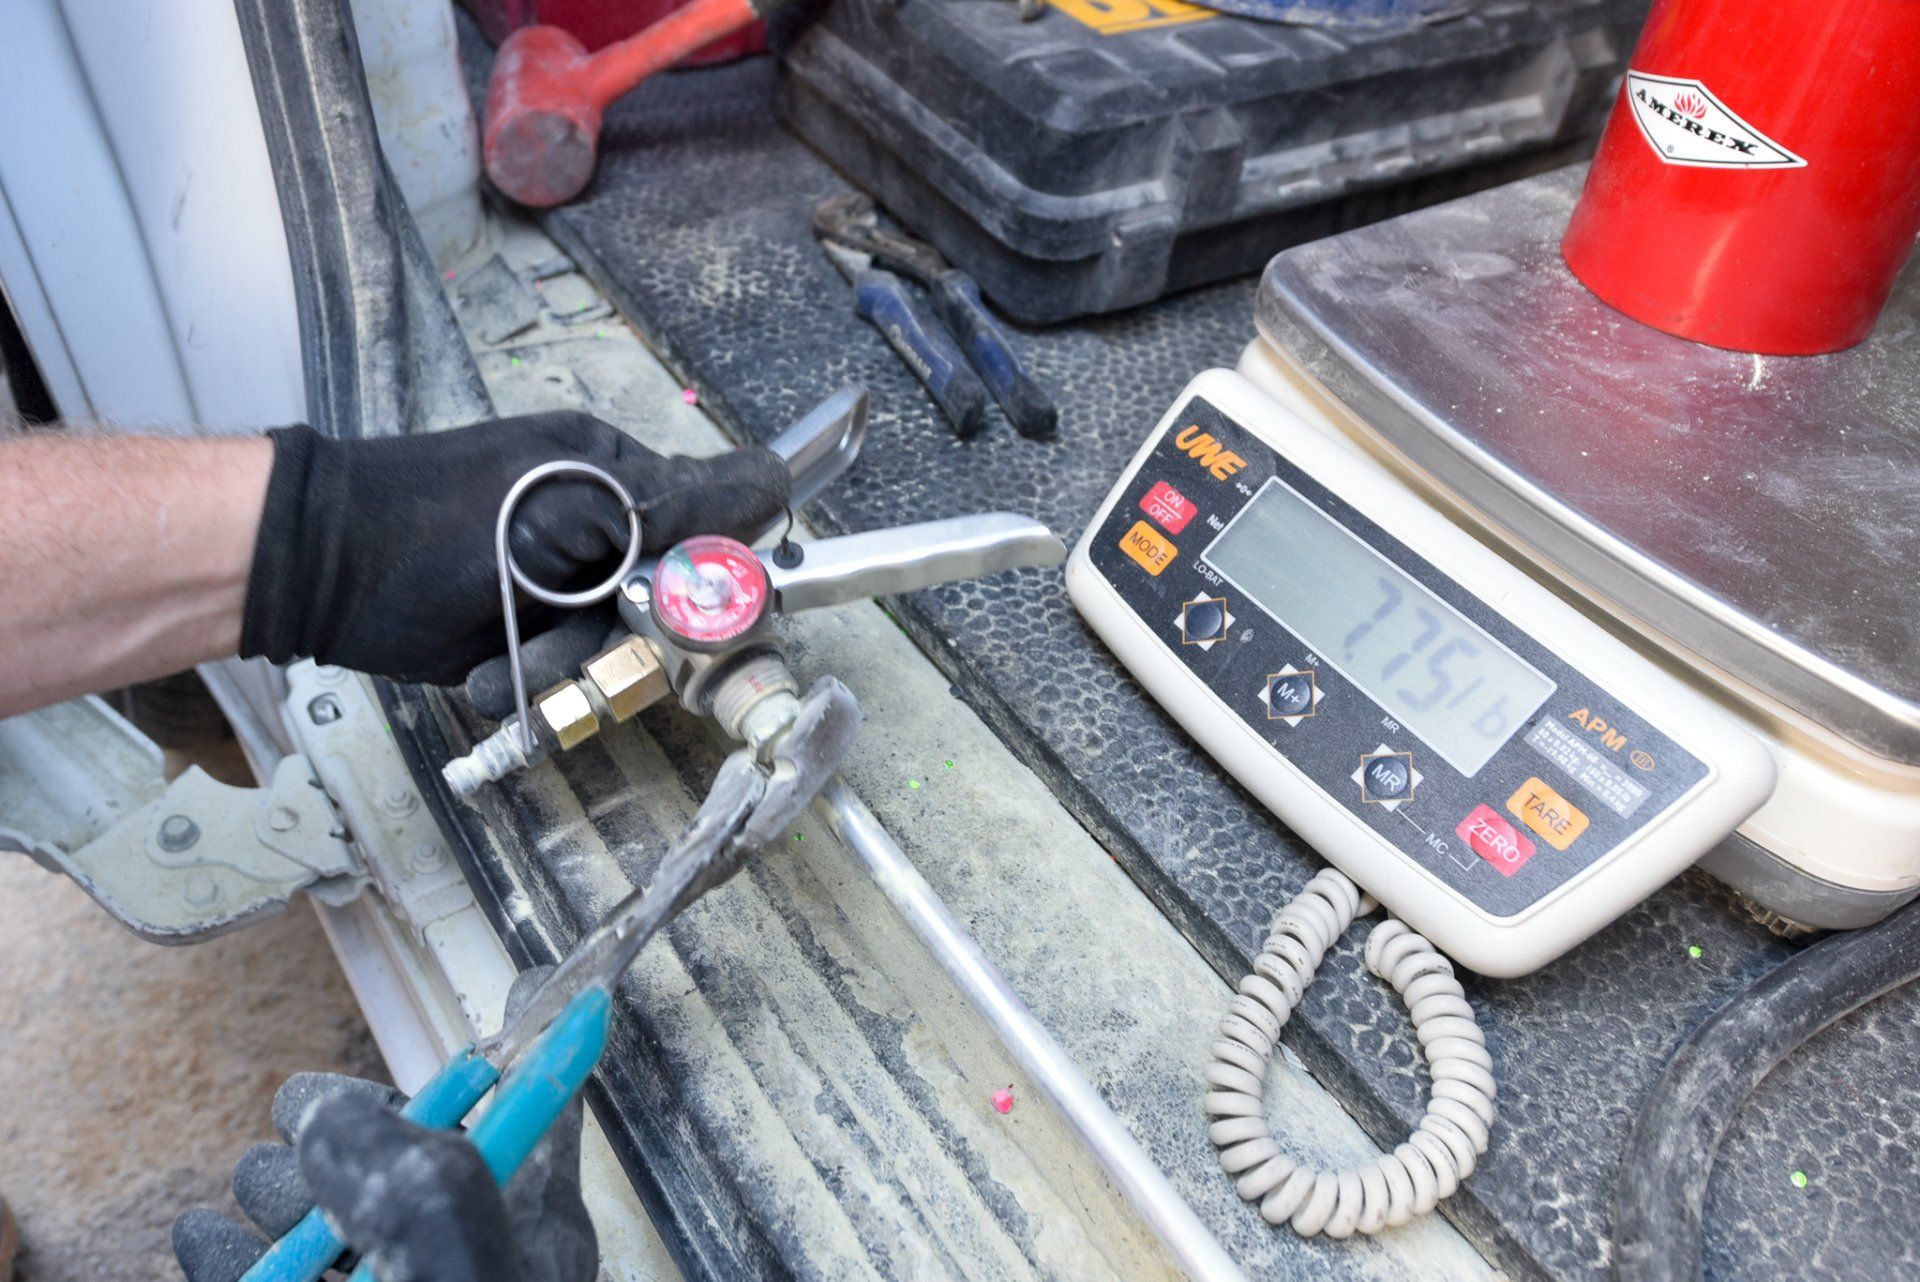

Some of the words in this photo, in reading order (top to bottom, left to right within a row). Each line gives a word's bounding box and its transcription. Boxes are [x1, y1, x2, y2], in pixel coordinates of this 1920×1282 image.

[1636, 88, 1758, 156] AMEREX
[1175, 424, 1248, 481] UWE
[1164, 490, 1184, 508] ON
[1149, 503, 1173, 525] OFF
[1206, 513, 1225, 531] Net
[1130, 531, 1168, 566] MODE
[1193, 560, 1224, 587] LO-BAT
[1304, 653, 1320, 667] M+
[1276, 683, 1299, 703] M+
[1381, 716, 1400, 734] MR
[1568, 707, 1628, 752] APM
[1371, 763, 1401, 792] MR
[1523, 792, 1573, 836] TARE
[1425, 832, 1449, 855] MC
[1469, 818, 1521, 863] ZERO
